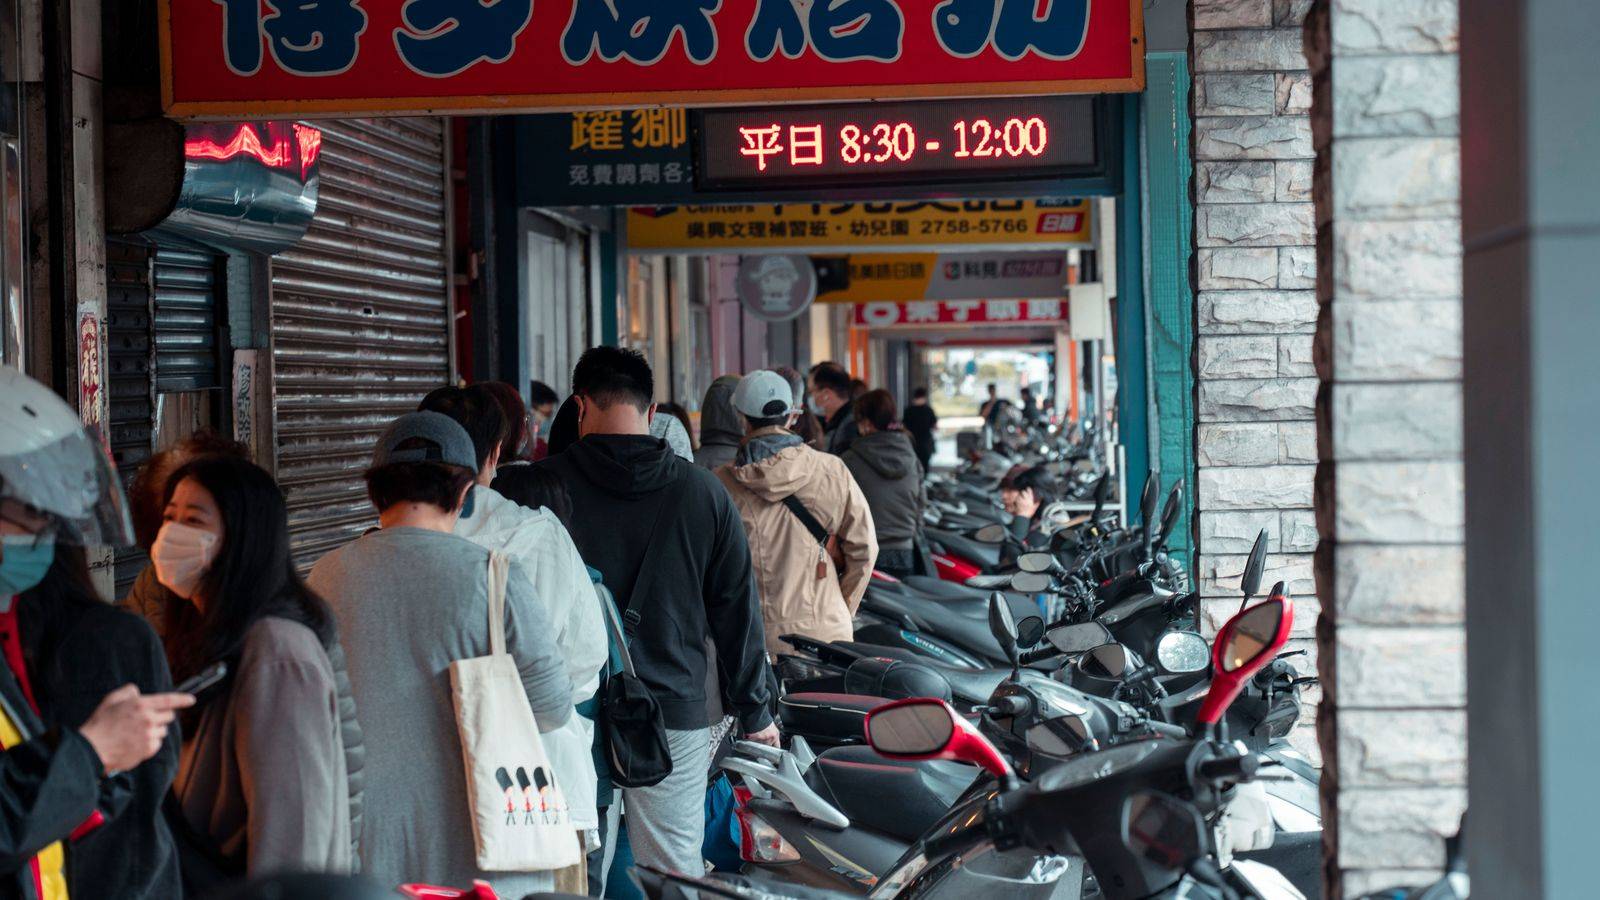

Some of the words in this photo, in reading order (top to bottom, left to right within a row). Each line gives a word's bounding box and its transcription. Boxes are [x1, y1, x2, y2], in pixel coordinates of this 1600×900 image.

[739, 123, 823, 172] 平日
[840, 123, 917, 164] 8:30
[926, 140, 940, 152] -
[953, 117, 1048, 158] 12:00
[921, 218, 1028, 234] 2758-5766
